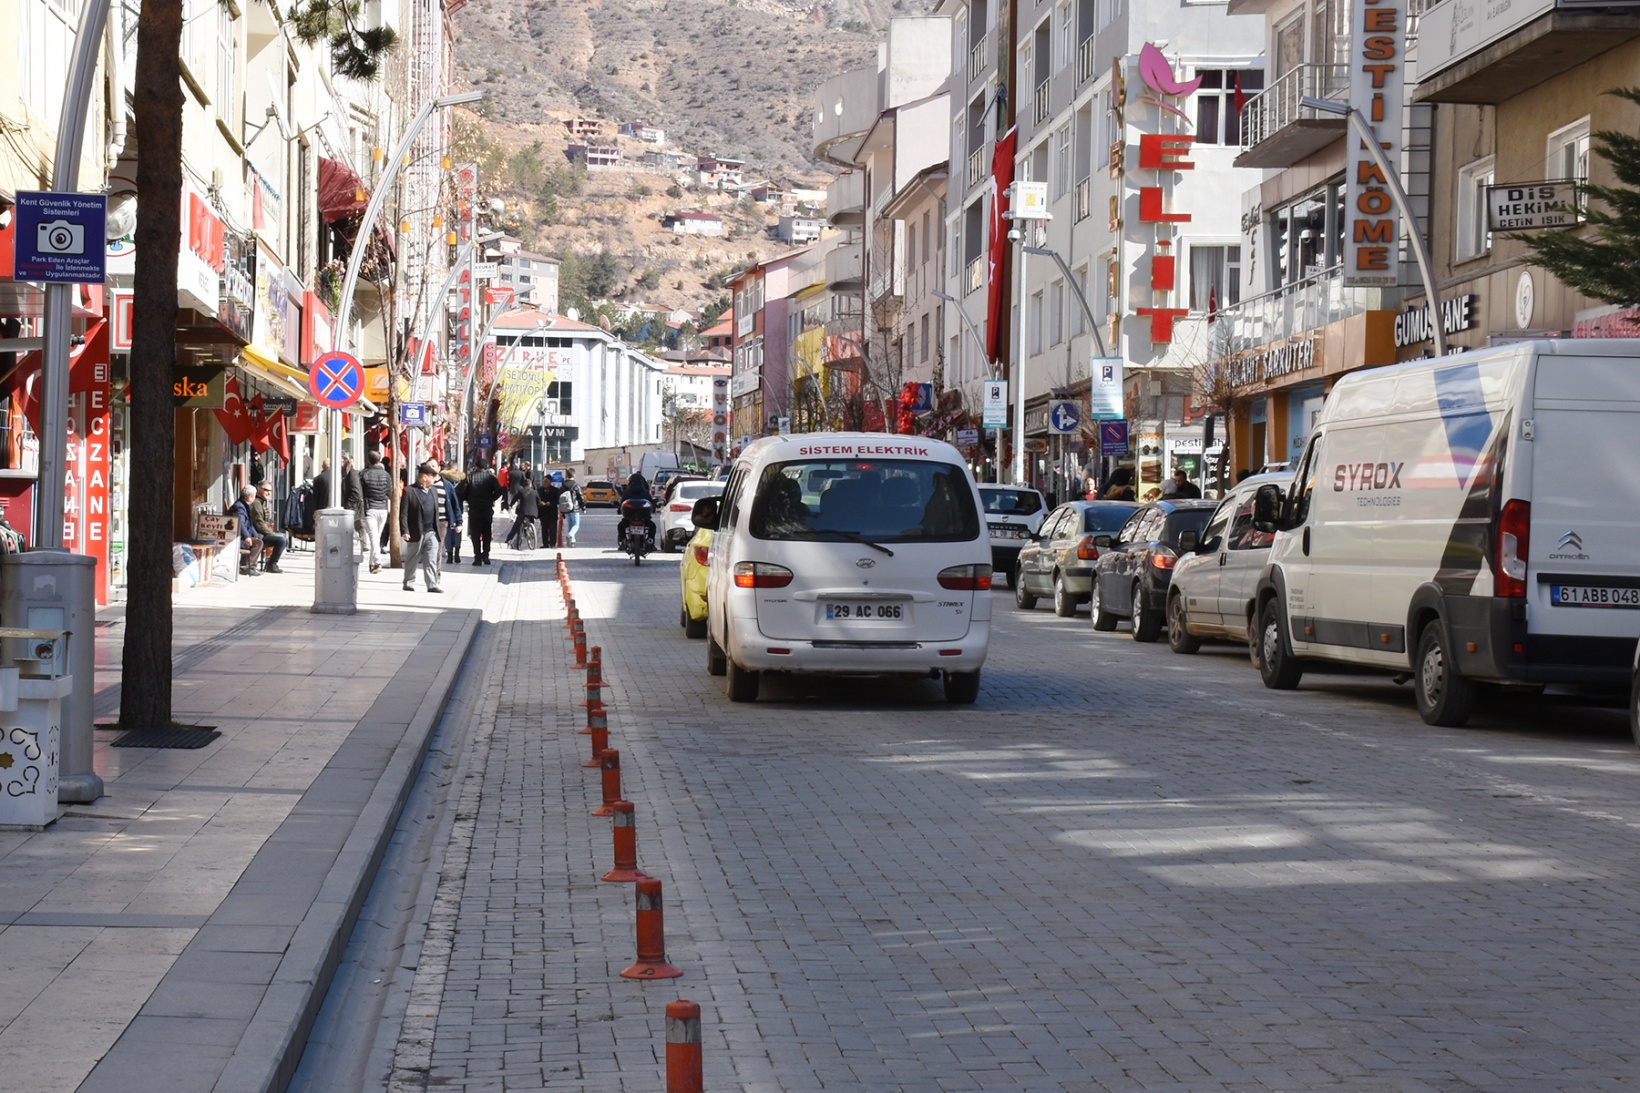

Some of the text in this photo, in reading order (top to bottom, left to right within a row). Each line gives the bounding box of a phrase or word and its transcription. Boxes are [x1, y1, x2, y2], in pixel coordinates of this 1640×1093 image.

[20, 198, 102, 209] Kent Güvenlik Yönetim
[43, 208, 80, 216] Sistemleri
[1136, 133, 1197, 344] ELİT
[1394, 294, 1470, 347] GÜMÜŞANE
[799, 445, 929, 456] SİSTEM ELEKTRİK
[90, 390, 104, 541] ECZANE
[1333, 461, 1405, 492] SYROX
[1356, 496, 1401, 507] TECHNOLOGIES
[1561, 587, 1640, 604] 61 ABB 048
[834, 605, 901, 618] 29 AC 066
